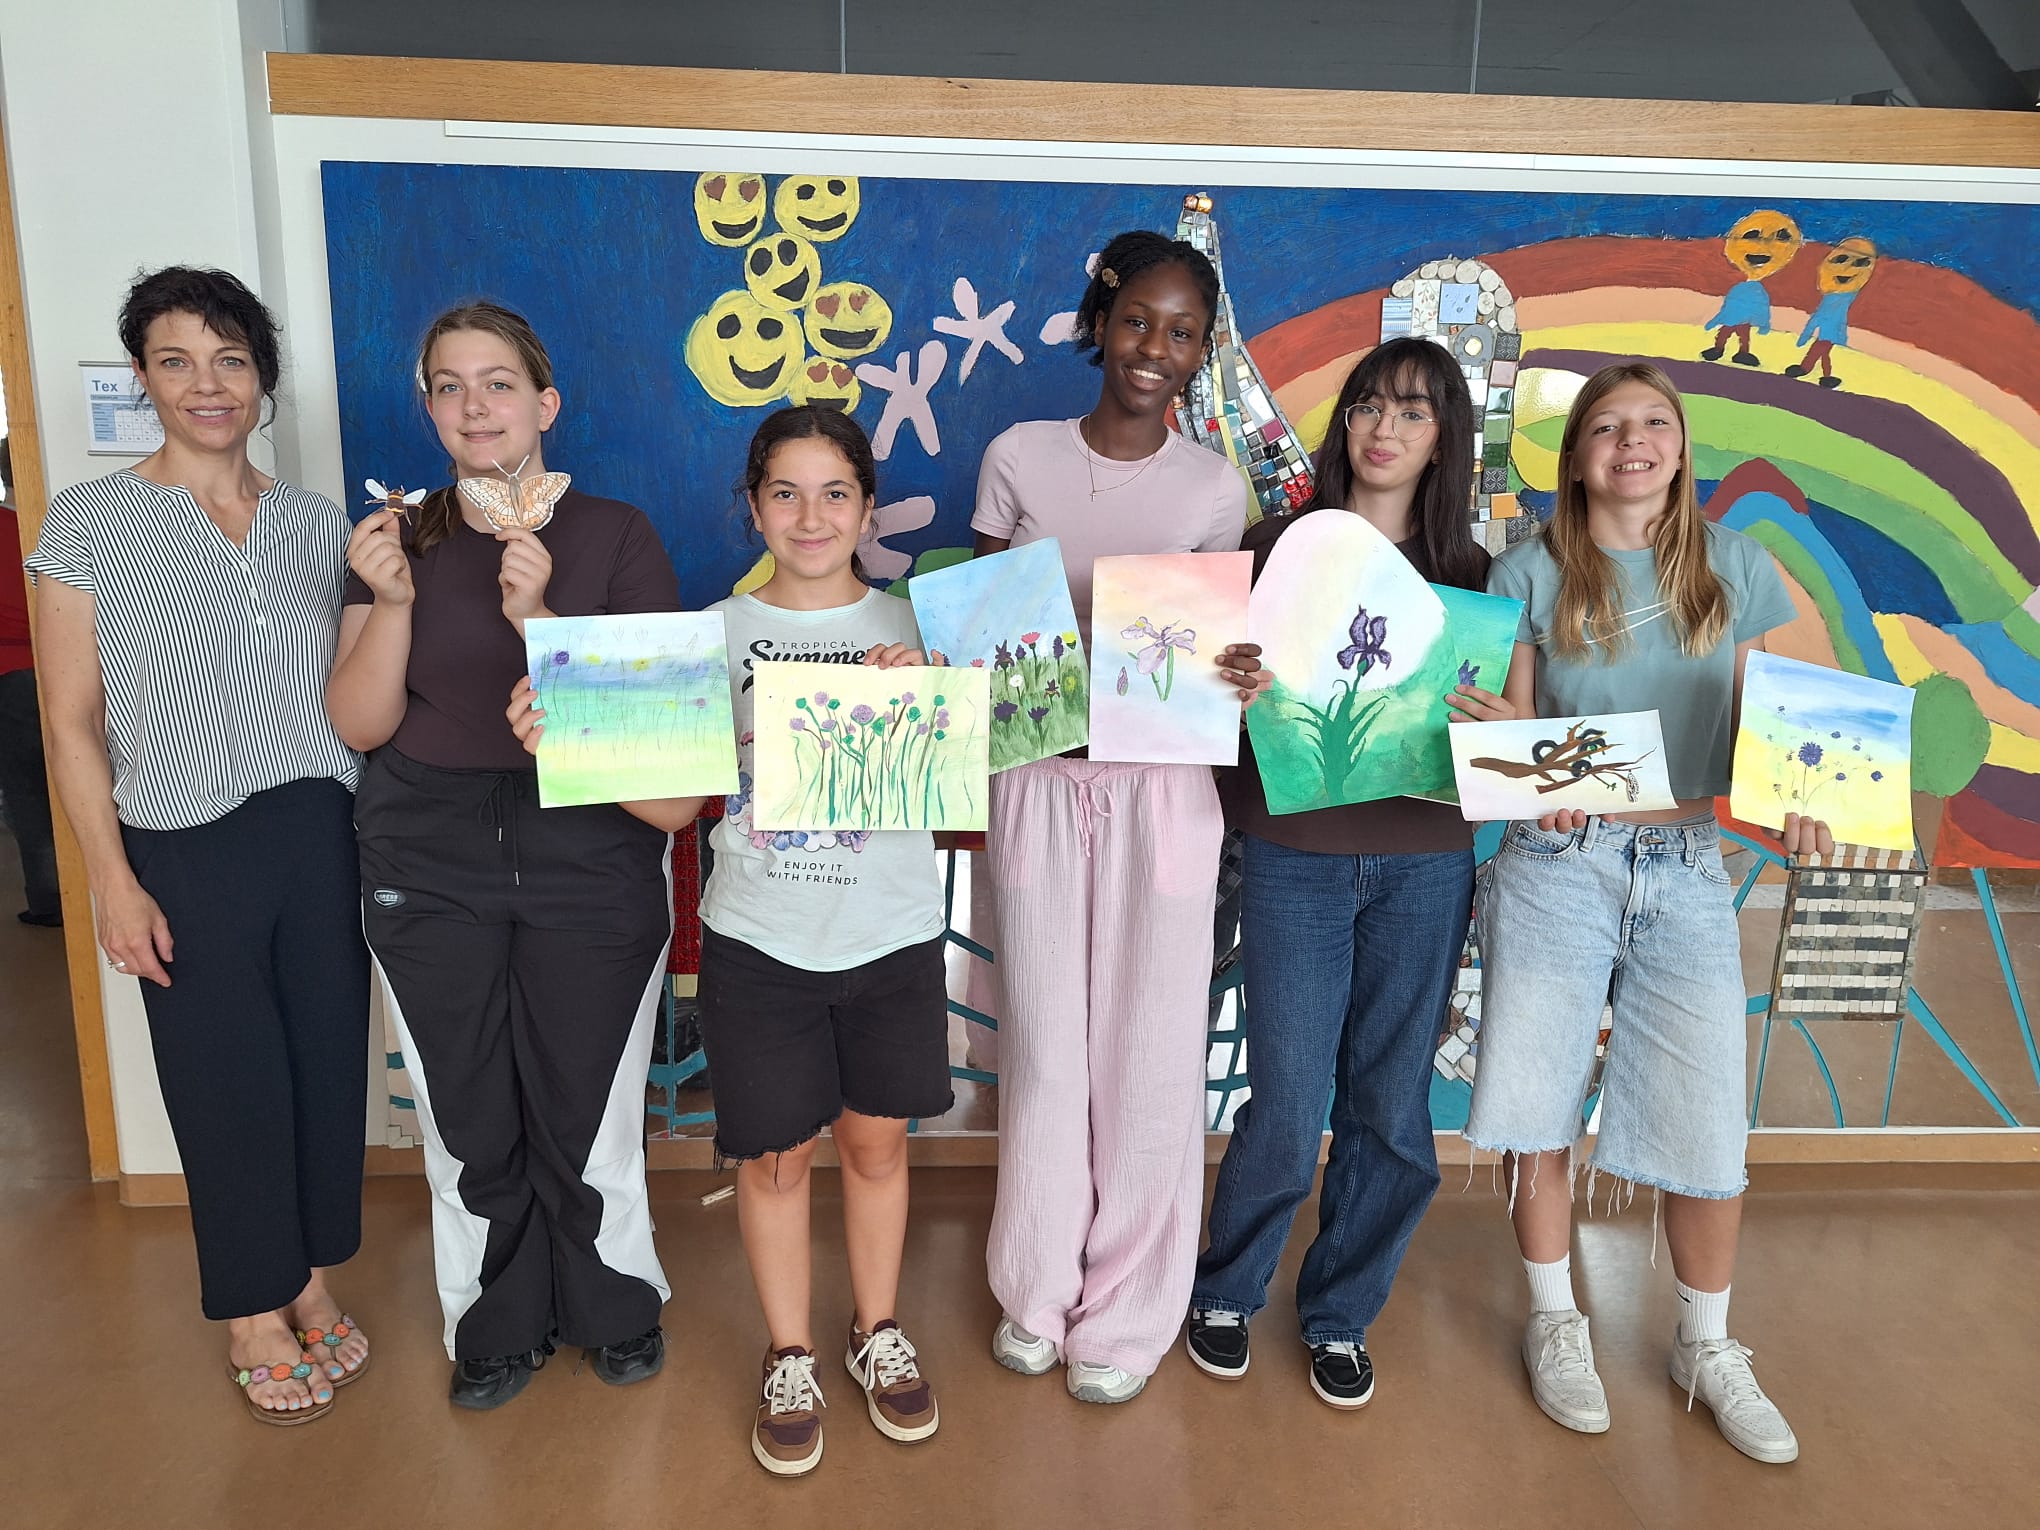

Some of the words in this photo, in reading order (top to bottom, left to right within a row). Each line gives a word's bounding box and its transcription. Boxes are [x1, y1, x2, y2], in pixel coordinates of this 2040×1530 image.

[92, 380, 118, 392] Tex
[781, 640, 857, 650] TROPICAL
[743, 640, 870, 670] Summe
[784, 861, 826, 871] ENJOY
[831, 864, 843, 872] IT
[767, 870, 800, 881] WITH
[806, 874, 858, 885] FRIENDS
